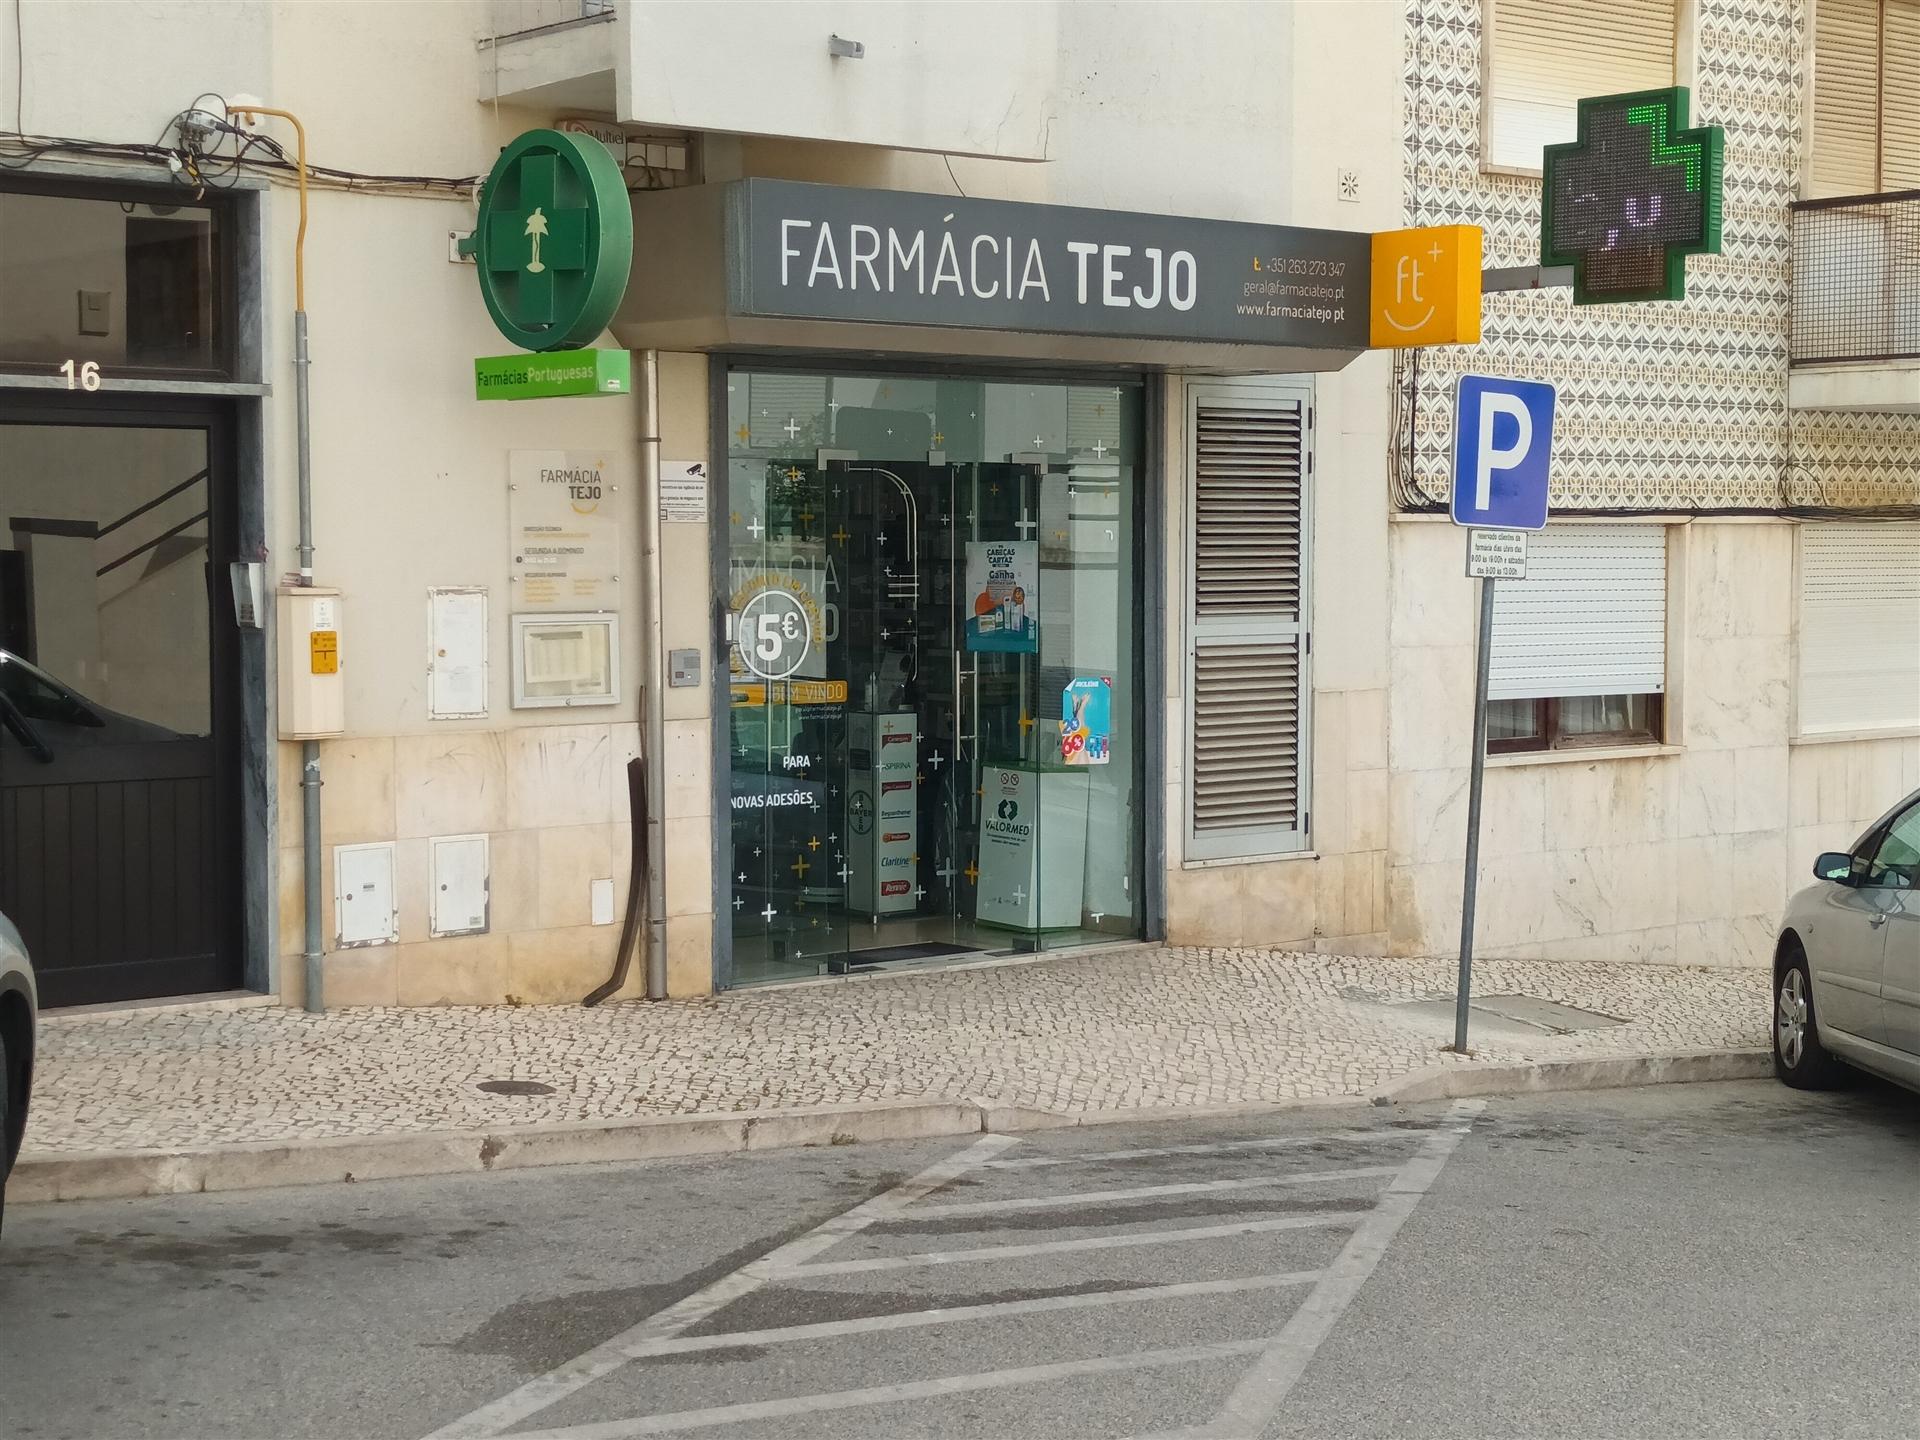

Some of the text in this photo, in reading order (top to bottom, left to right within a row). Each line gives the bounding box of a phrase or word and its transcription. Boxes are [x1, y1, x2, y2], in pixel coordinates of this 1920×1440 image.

[781, 213, 1198, 312] FARMÁCIA TEJO
[1288, 259, 1307, 275] 263
[1309, 260, 1327, 276] 273
[1328, 262, 1346, 277] 347
[1244, 280, 1345, 302] geral@farmaciatejo.pt
[1236, 301, 1345, 323] www.farmaciatejopt
[60, 359, 101, 392] 16
[1475, 391, 1533, 511] P
[540, 466, 602, 484] FARMÁCIA
[568, 486, 602, 500] TEJO
[989, 570, 1015, 580] Ganha
[783, 755, 811, 769] PARA
[730, 789, 813, 809] NOVAS ADESÕES
